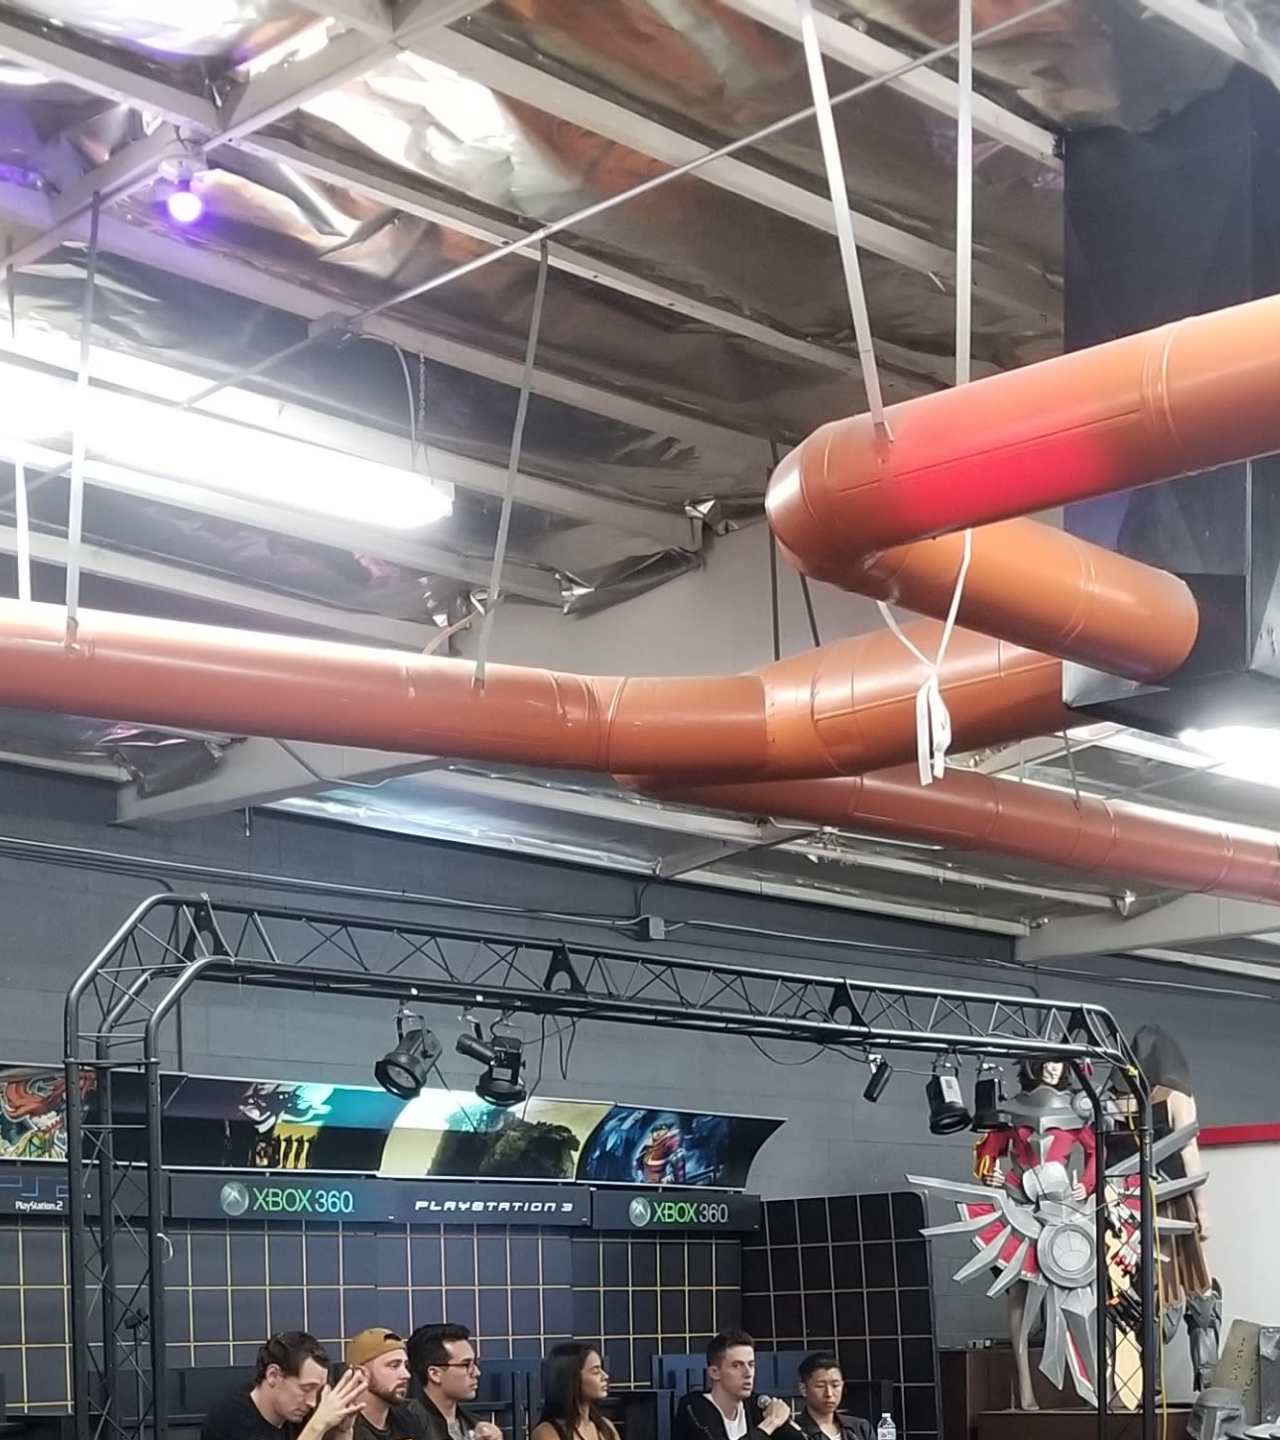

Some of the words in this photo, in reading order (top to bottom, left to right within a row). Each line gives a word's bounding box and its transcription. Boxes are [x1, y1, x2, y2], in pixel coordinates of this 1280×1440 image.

[252, 1187, 313, 1213] XBOX
[314, 1190, 354, 1214] 360
[414, 1200, 557, 1213] PLAYSTATION
[560, 1202, 574, 1212] 3
[653, 1201, 698, 1223] XBOX
[699, 1203, 729, 1224] 360
